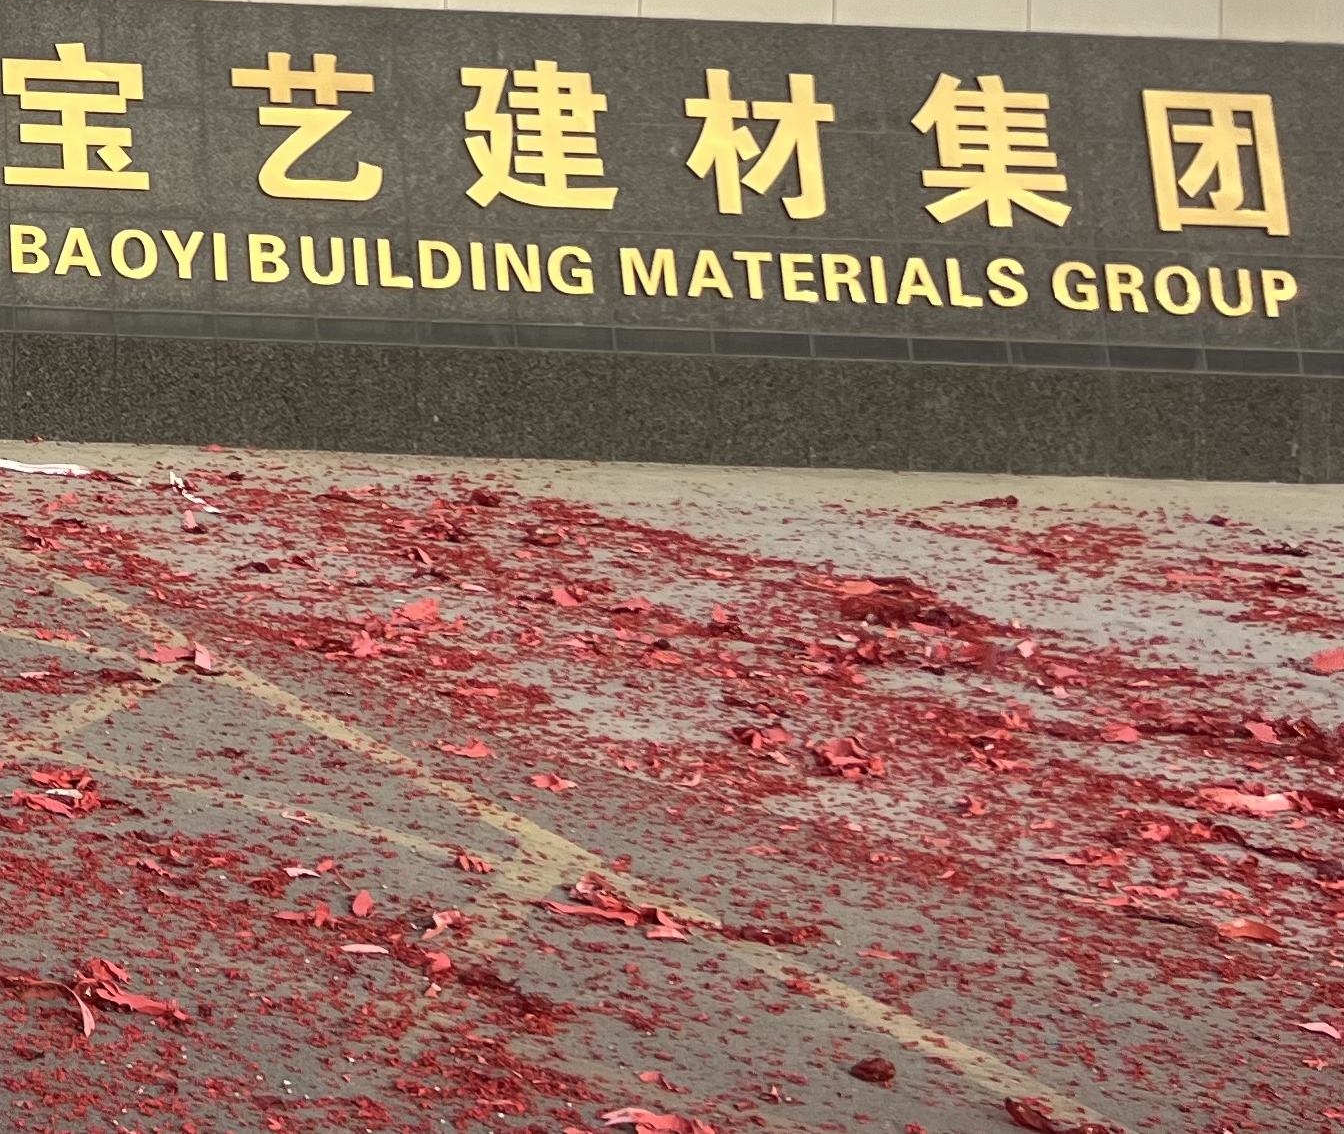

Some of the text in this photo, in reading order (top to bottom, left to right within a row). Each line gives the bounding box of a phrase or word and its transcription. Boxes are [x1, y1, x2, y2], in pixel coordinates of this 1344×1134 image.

[0, 42, 1293, 237] 宝艺建材集团
[8, 222, 1302, 318] BAOYI BUILDING MATERIALS GROUP
